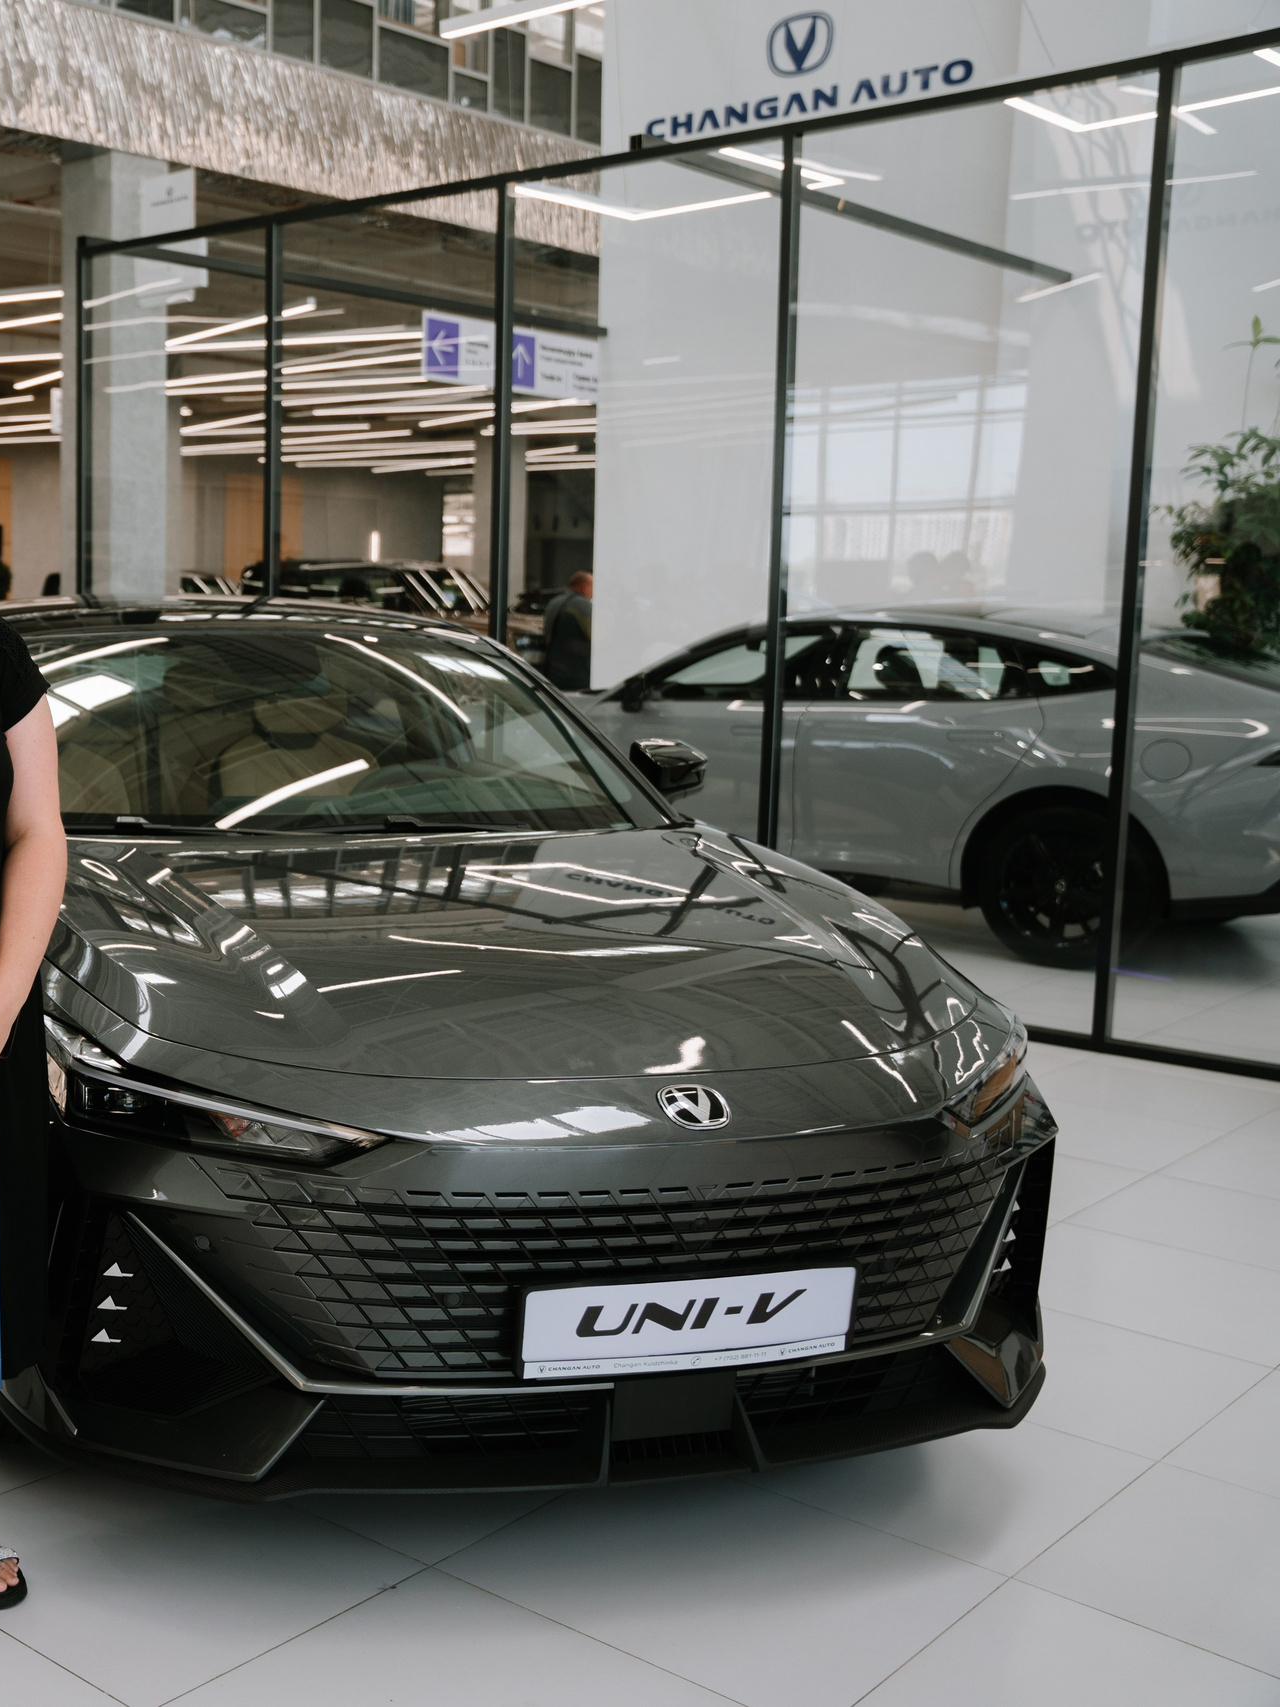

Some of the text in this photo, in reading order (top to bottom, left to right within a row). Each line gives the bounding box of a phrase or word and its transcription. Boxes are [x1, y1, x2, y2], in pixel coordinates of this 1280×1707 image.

[645, 59, 974, 139] CHANGAN AUTO
[575, 1288, 808, 1338] UNI-V
[787, 1341, 836, 1354] CHANGAN AUTO
